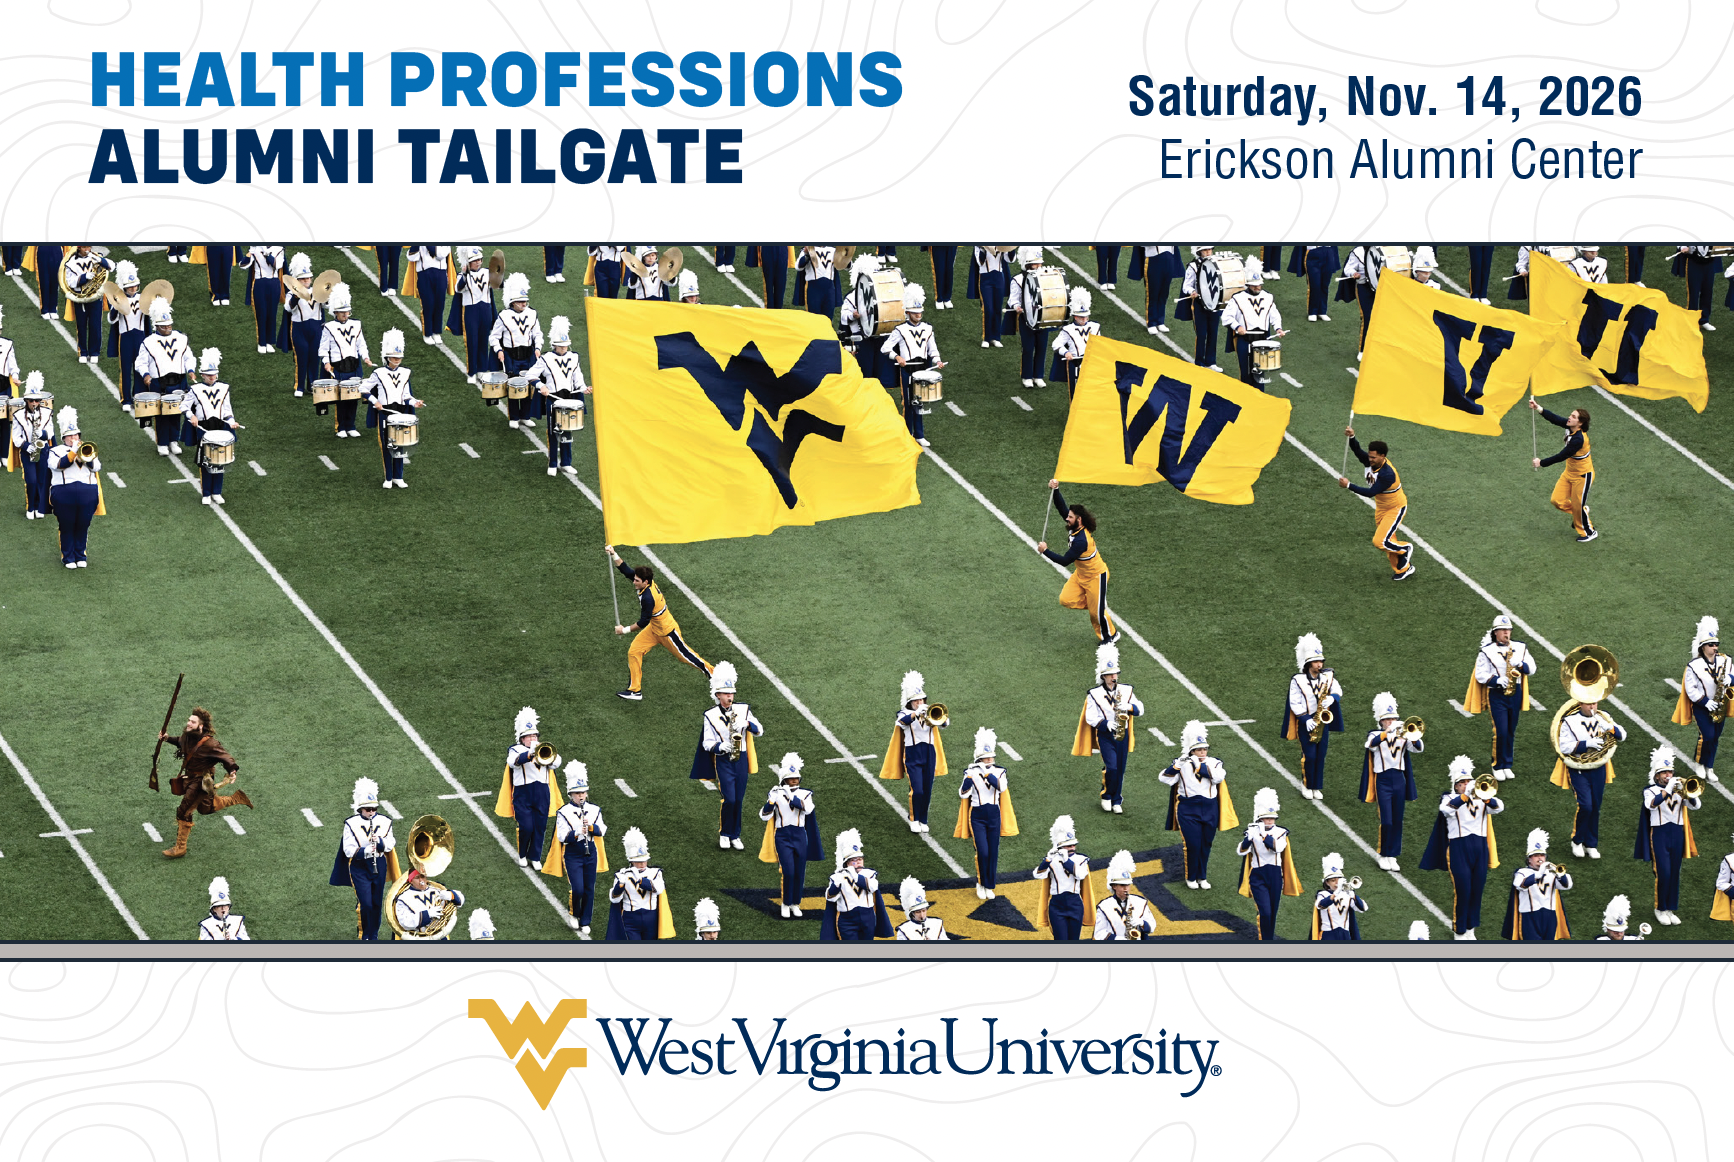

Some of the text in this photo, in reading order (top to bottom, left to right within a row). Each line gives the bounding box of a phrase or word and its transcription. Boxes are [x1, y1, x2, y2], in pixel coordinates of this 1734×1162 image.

[654, 331, 844, 510] WV
[1114, 361, 1242, 492] W
[1432, 310, 1515, 415] V
